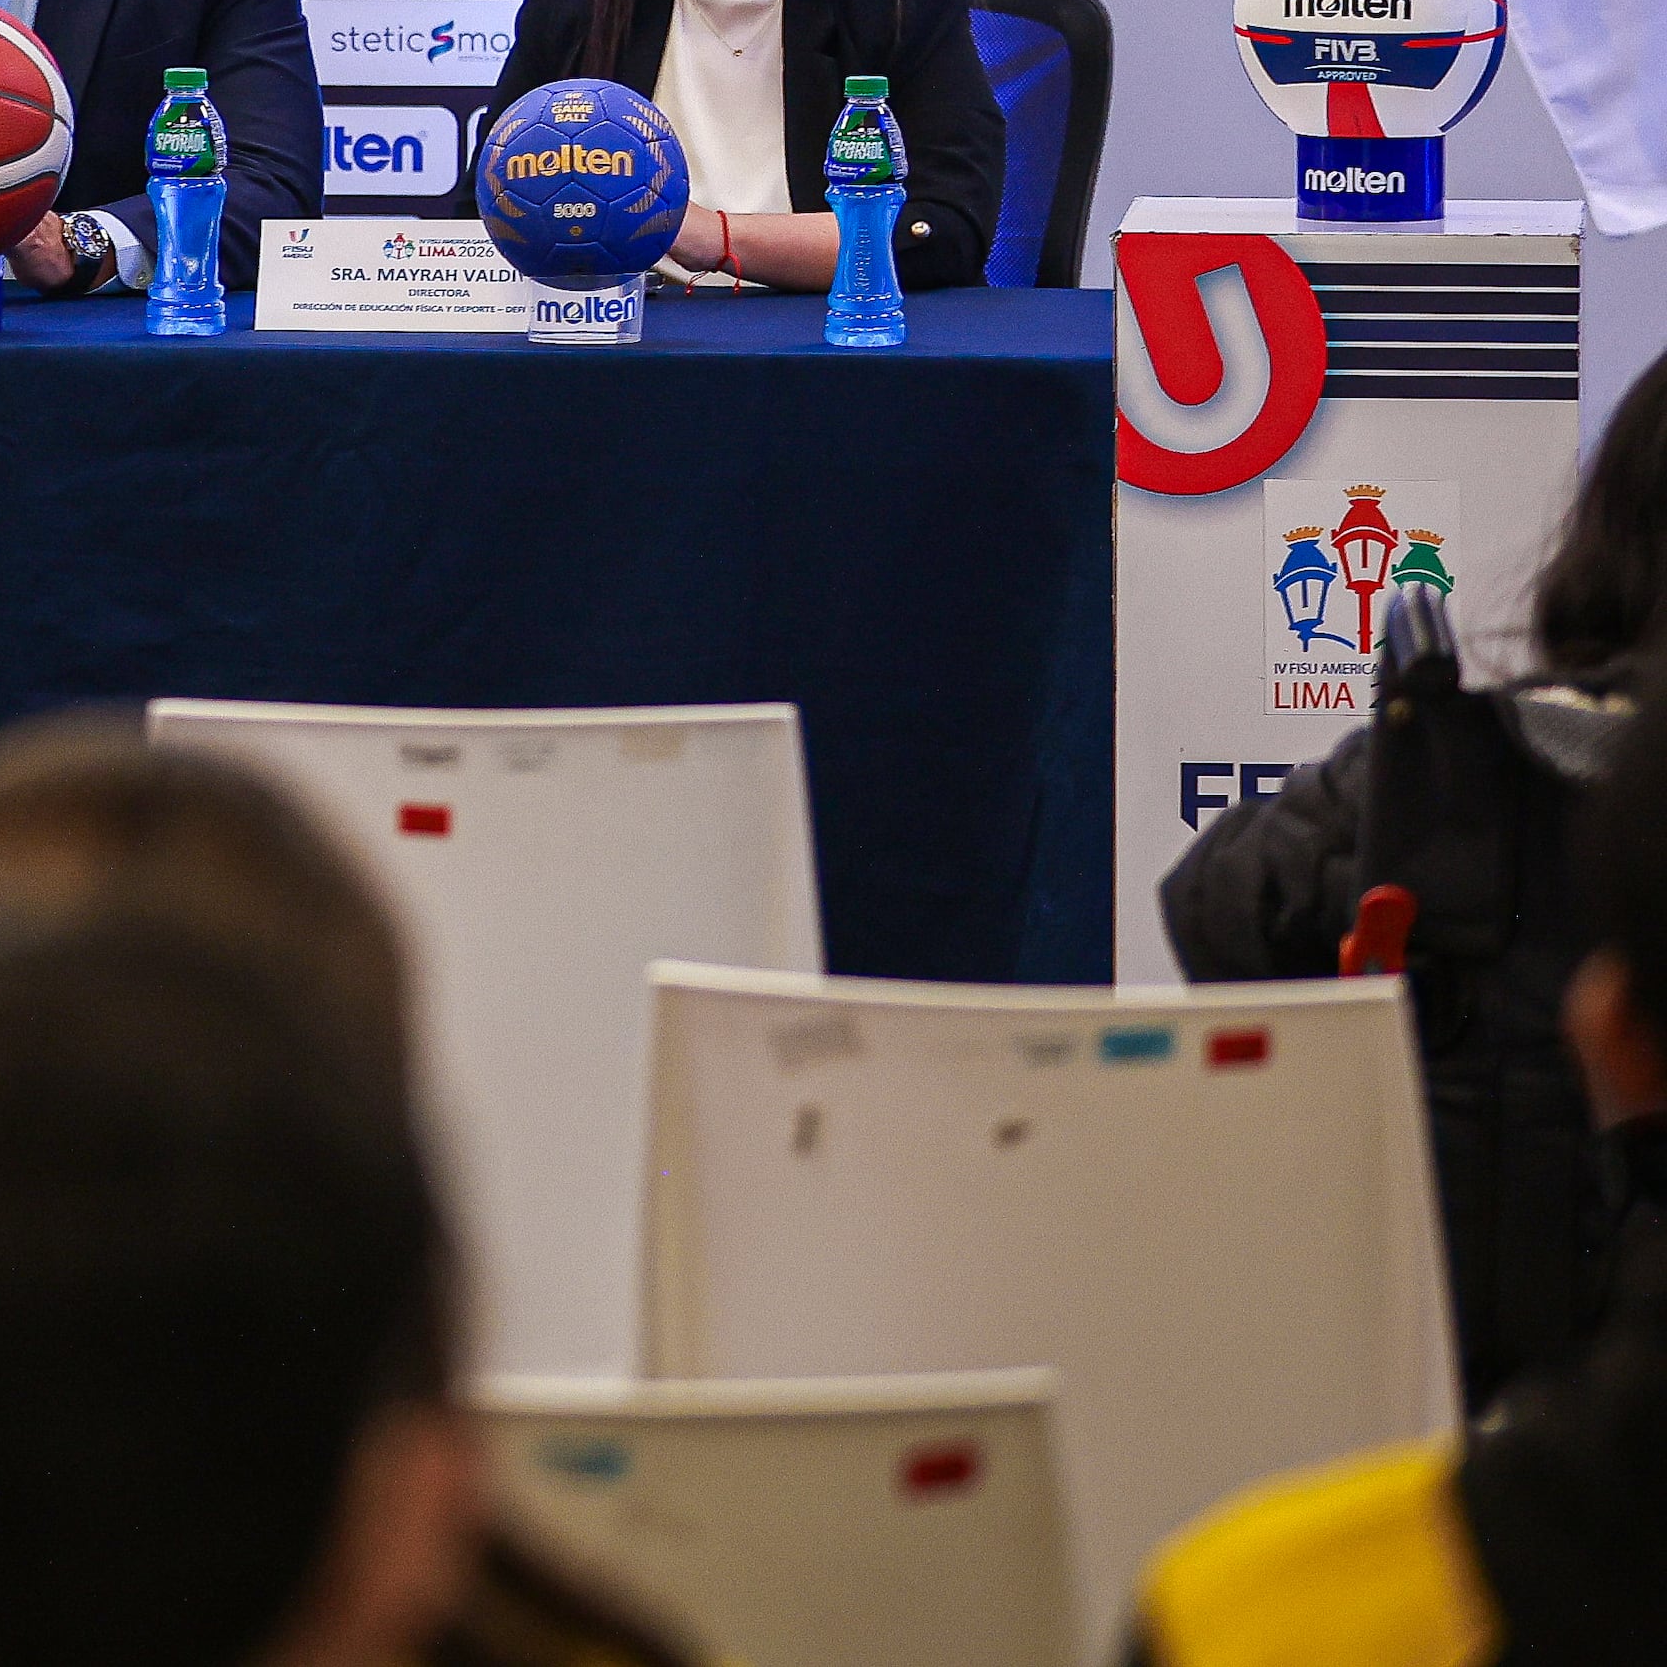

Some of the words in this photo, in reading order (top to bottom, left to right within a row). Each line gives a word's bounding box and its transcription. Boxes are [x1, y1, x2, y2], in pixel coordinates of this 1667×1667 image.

[1317, 70, 1377, 81] APPROVED
[506, 144, 635, 180] molten
[1304, 167, 1406, 194] molten
[458, 246, 495, 258] 2026
[331, 267, 371, 281] SRA.
[377, 268, 457, 282] MAYRAH
[408, 288, 471, 298] DIRECTORA
[536, 295, 637, 324] molten
[1274, 681, 1356, 709] LIMA
